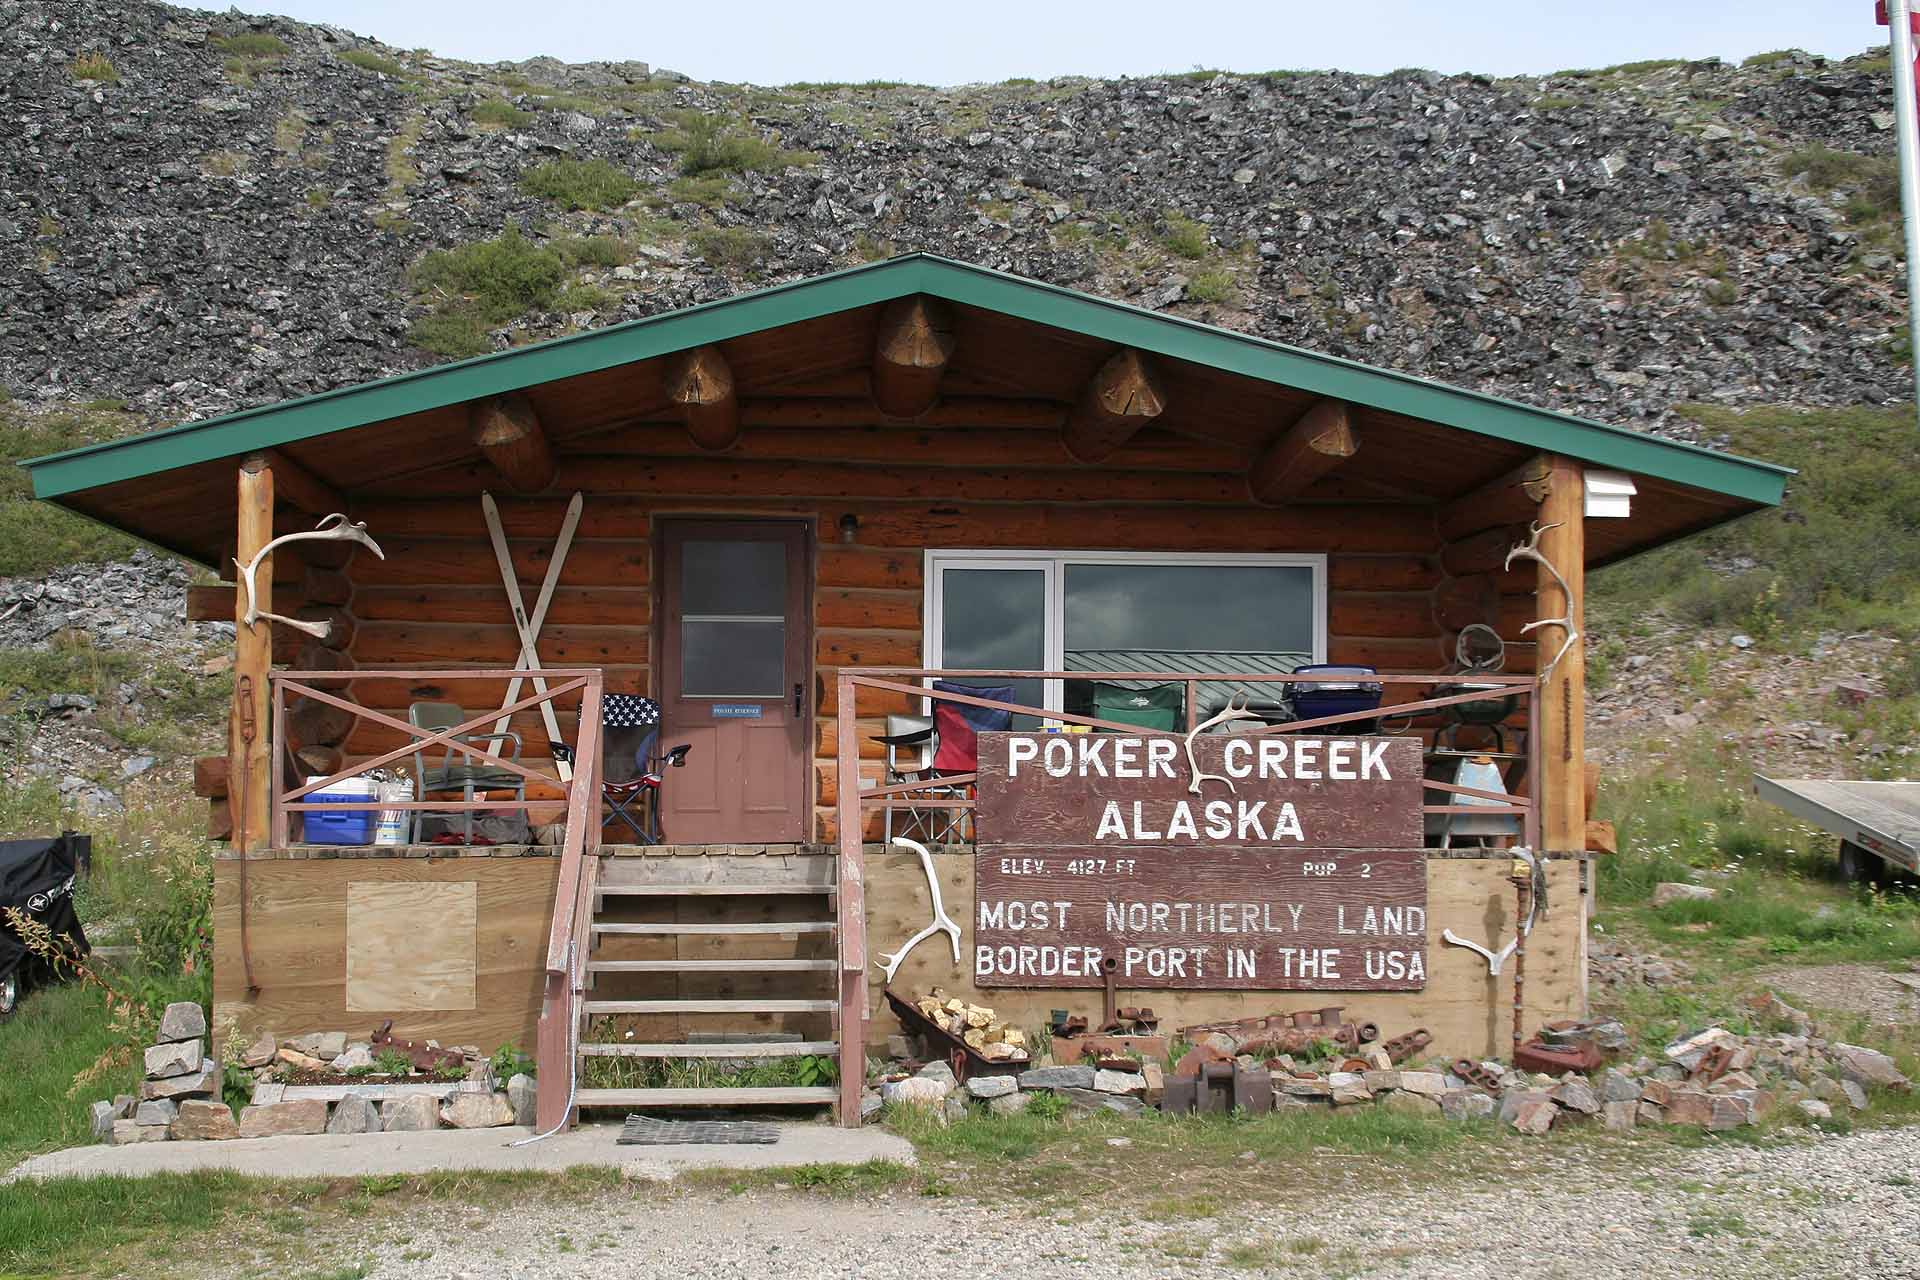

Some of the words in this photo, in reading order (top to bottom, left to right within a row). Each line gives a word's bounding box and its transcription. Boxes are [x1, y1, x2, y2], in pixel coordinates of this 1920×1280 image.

[1008, 737, 1178, 779] POKER
[1224, 739, 1392, 781] CREEK
[1095, 800, 1304, 841] ALASKA
[1066, 859, 1106, 876] 4127
[1115, 859, 1136, 876] FT
[1360, 863, 1372, 878] 2
[979, 901, 1072, 931] MOST
[1105, 902, 1304, 934] NORTHERLY
[1337, 905, 1426, 936] LAND
[976, 946, 1103, 977] BORDER
[1125, 947, 1208, 978] PORT
[1226, 948, 1256, 979] IN
[1278, 948, 1340, 979] THE
[1366, 951, 1426, 981] USA
